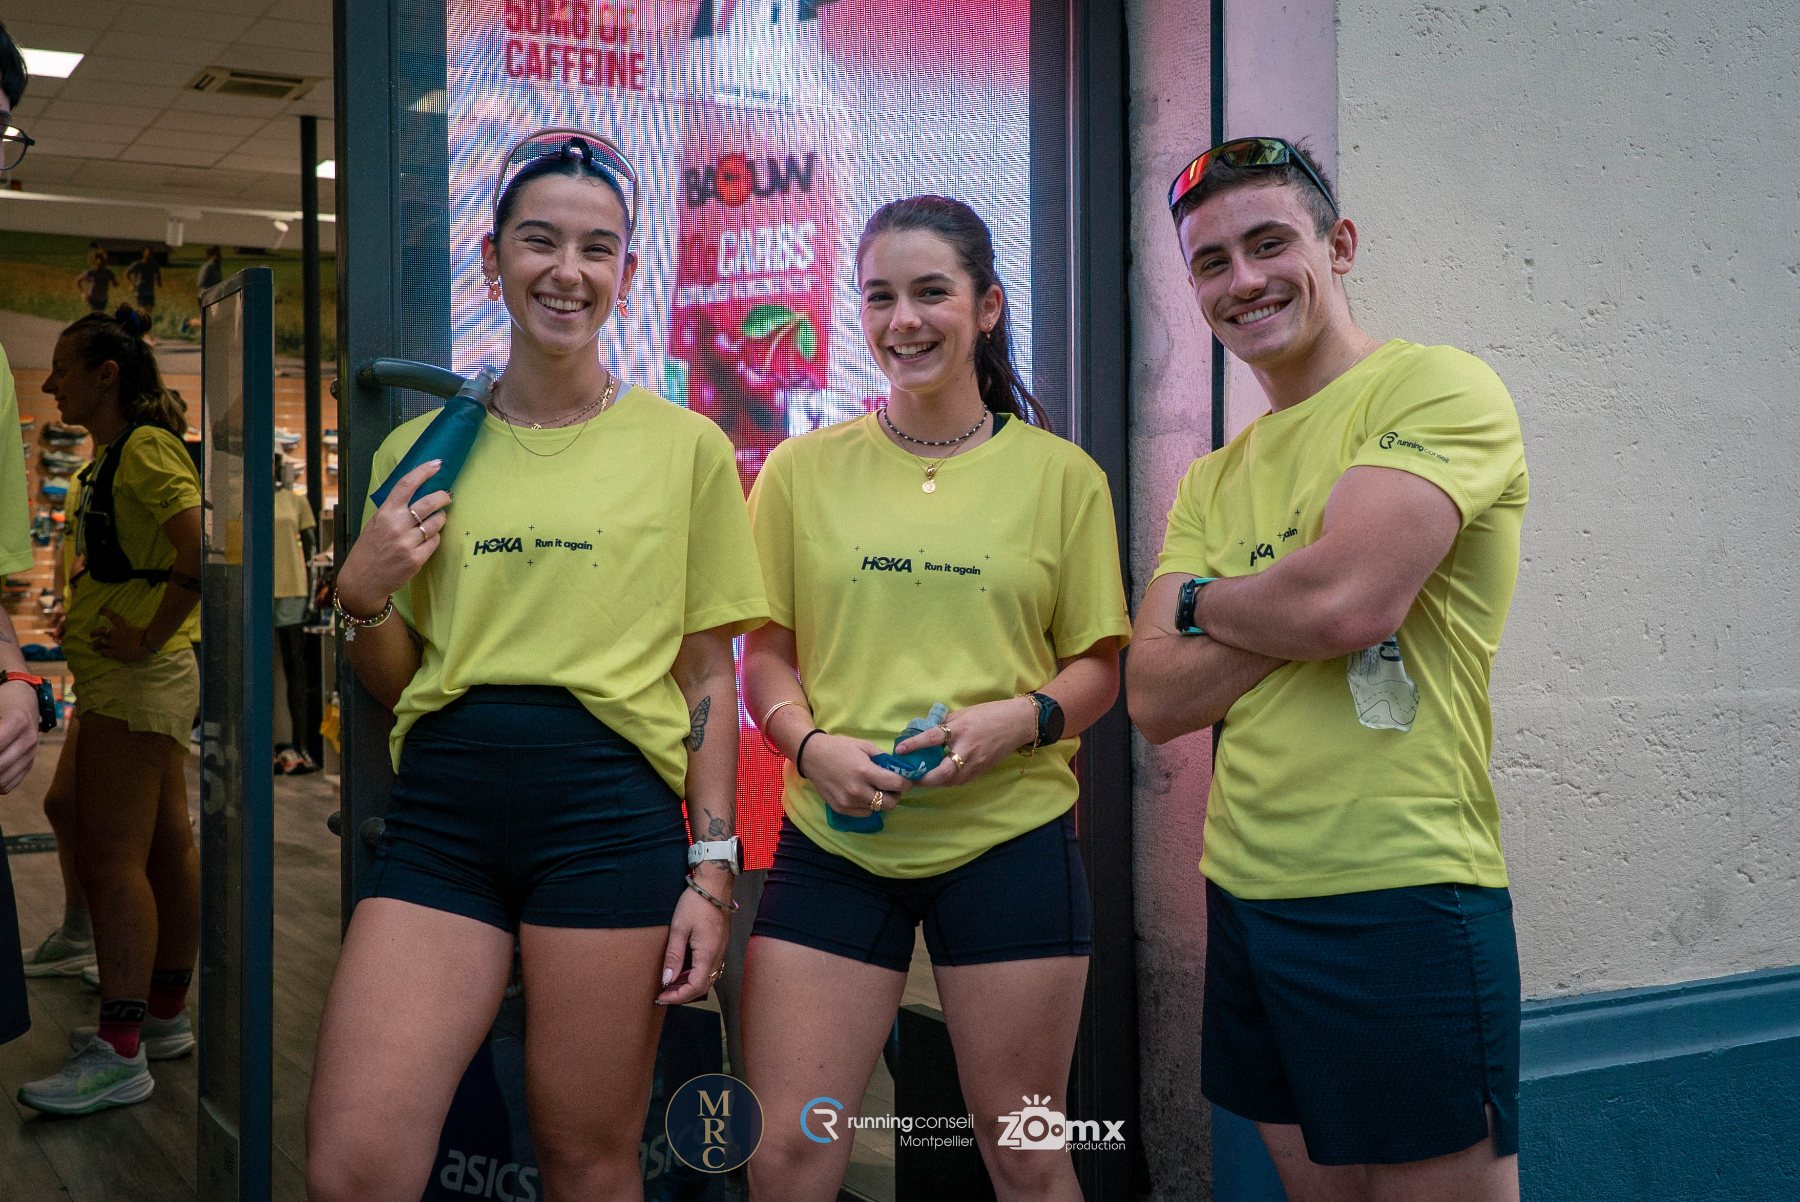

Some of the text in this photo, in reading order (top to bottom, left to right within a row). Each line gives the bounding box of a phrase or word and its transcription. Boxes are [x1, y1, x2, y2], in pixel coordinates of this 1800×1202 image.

[506, 39, 646, 91] CAFFEINE
[473, 537, 593, 556] HOKA Run it again
[861, 556, 981, 576] HOKA Run it again
